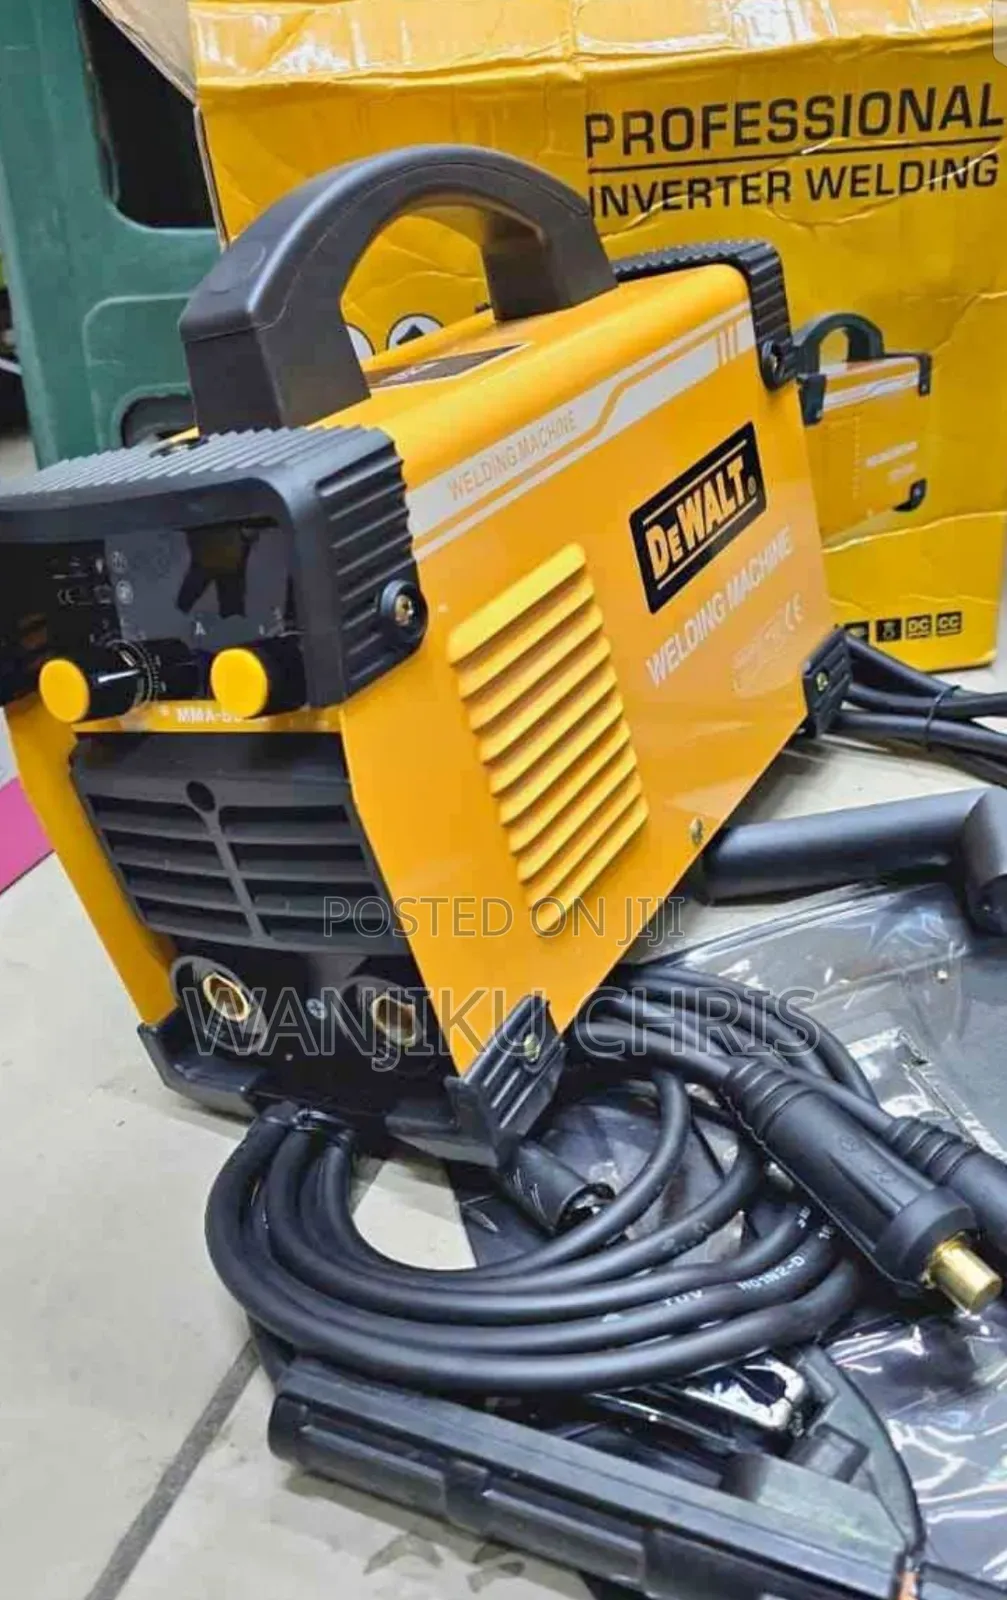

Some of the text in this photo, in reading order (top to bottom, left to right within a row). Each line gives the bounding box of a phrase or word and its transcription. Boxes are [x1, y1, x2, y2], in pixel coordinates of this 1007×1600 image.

[585, 83, 1005, 157] PROFESSIONAL
[589, 154, 999, 218] INVERTER WELDING
[447, 410, 578, 501] WELDING MACHINE
[647, 594, 726, 686] WELDING
[727, 527, 794, 611] MACHINE
[908, 615, 959, 632] DC CC
